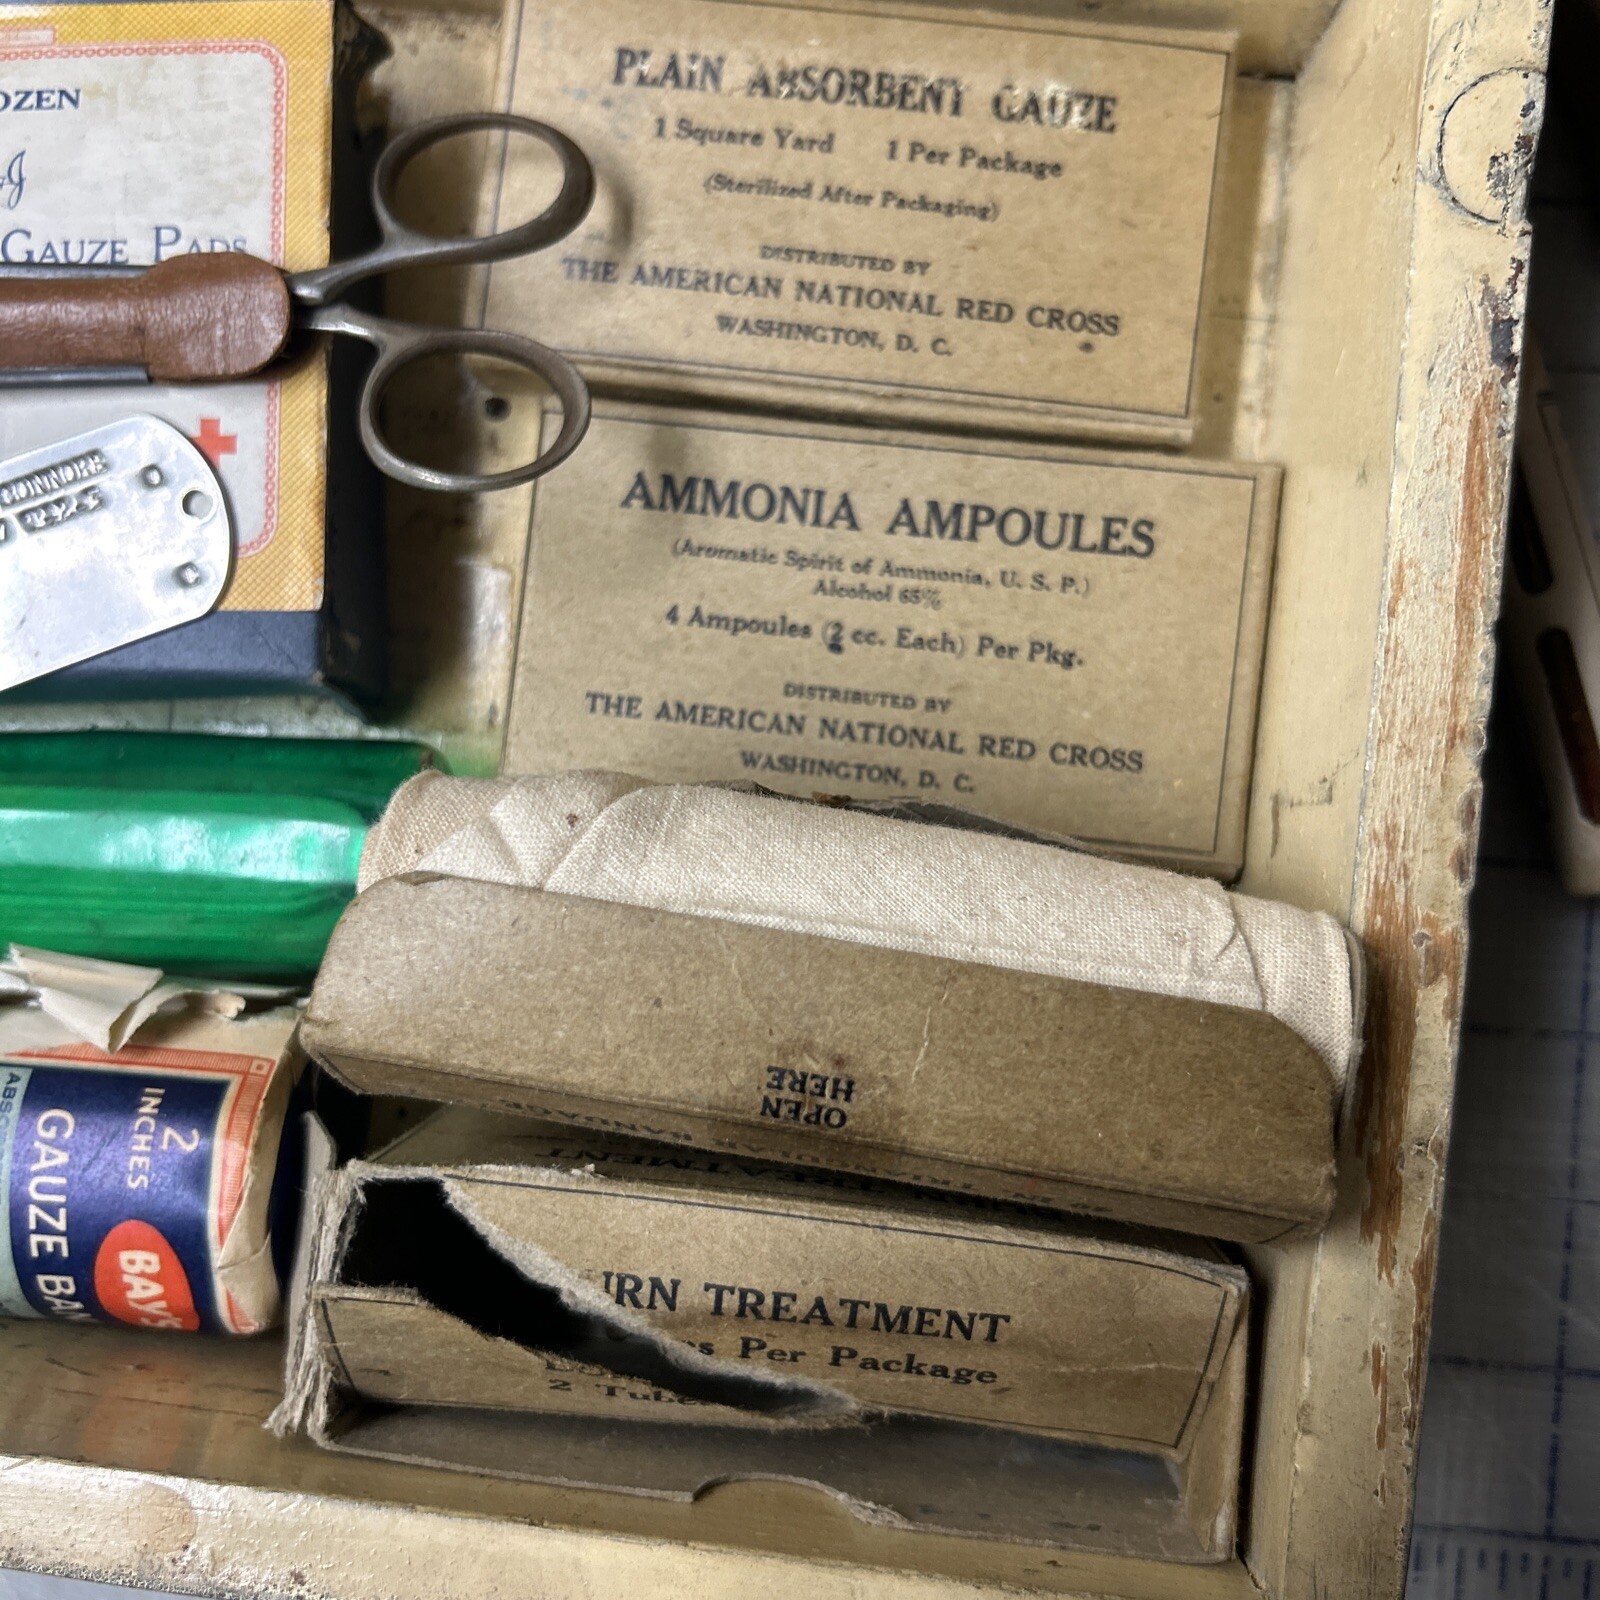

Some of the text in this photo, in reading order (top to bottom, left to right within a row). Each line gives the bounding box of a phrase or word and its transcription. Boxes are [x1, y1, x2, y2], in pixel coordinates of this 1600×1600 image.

[613, 46, 1119, 135] PLAIN ABSORBENT GAUZE
[655, 117, 837, 154] 1 Square Yard
[887, 140, 1064, 180] 1 Per Package
[703, 173, 1000, 223] (Sterilized After Packaging)
[758, 246, 932, 276] DISTRIBUTED BY
[562, 257, 1121, 338] THE AMERICAN NATIONAL RED CROSS
[714, 314, 955, 357] WASHINGTON, D. C.
[620, 472, 1156, 559] AMMONIA AMPOULES
[673, 537, 779, 566] (Aromatic
[784, 550, 845, 573] Spirit
[851, 557, 874, 577] of
[880, 560, 991, 588] Ammonia,
[1001, 570, 1023, 591] U.
[1030, 573, 1051, 593] S.
[813, 580, 894, 603] Alcohol
[665, 604, 679, 625] 4
[687, 606, 813, 637] Ampoules
[850, 628, 886, 647] cc.
[896, 626, 965, 660] Each)
[976, 635, 1019, 661] Per
[1026, 640, 1084, 671] Pkg.
[783, 682, 953, 713] DISTRIBUTED BY
[585, 691, 1144, 774] THE AMERICAN NATIONAL RED CROSS
[739, 751, 976, 793] WASHINGTON, D. C.
[766, 1065, 855, 1103] HERE
[760, 1095, 847, 1129] OPEN
[127, 1087, 166, 1190] INCHES
[160, 1127, 200, 1153] 2
[27, 1108, 76, 1258] GAUZE
[704, 1282, 1010, 1342] TREATMENT
[738, 1336, 807, 1363] Per
[828, 1346, 998, 1384] Package
[549, 1378, 571, 1391] 2
